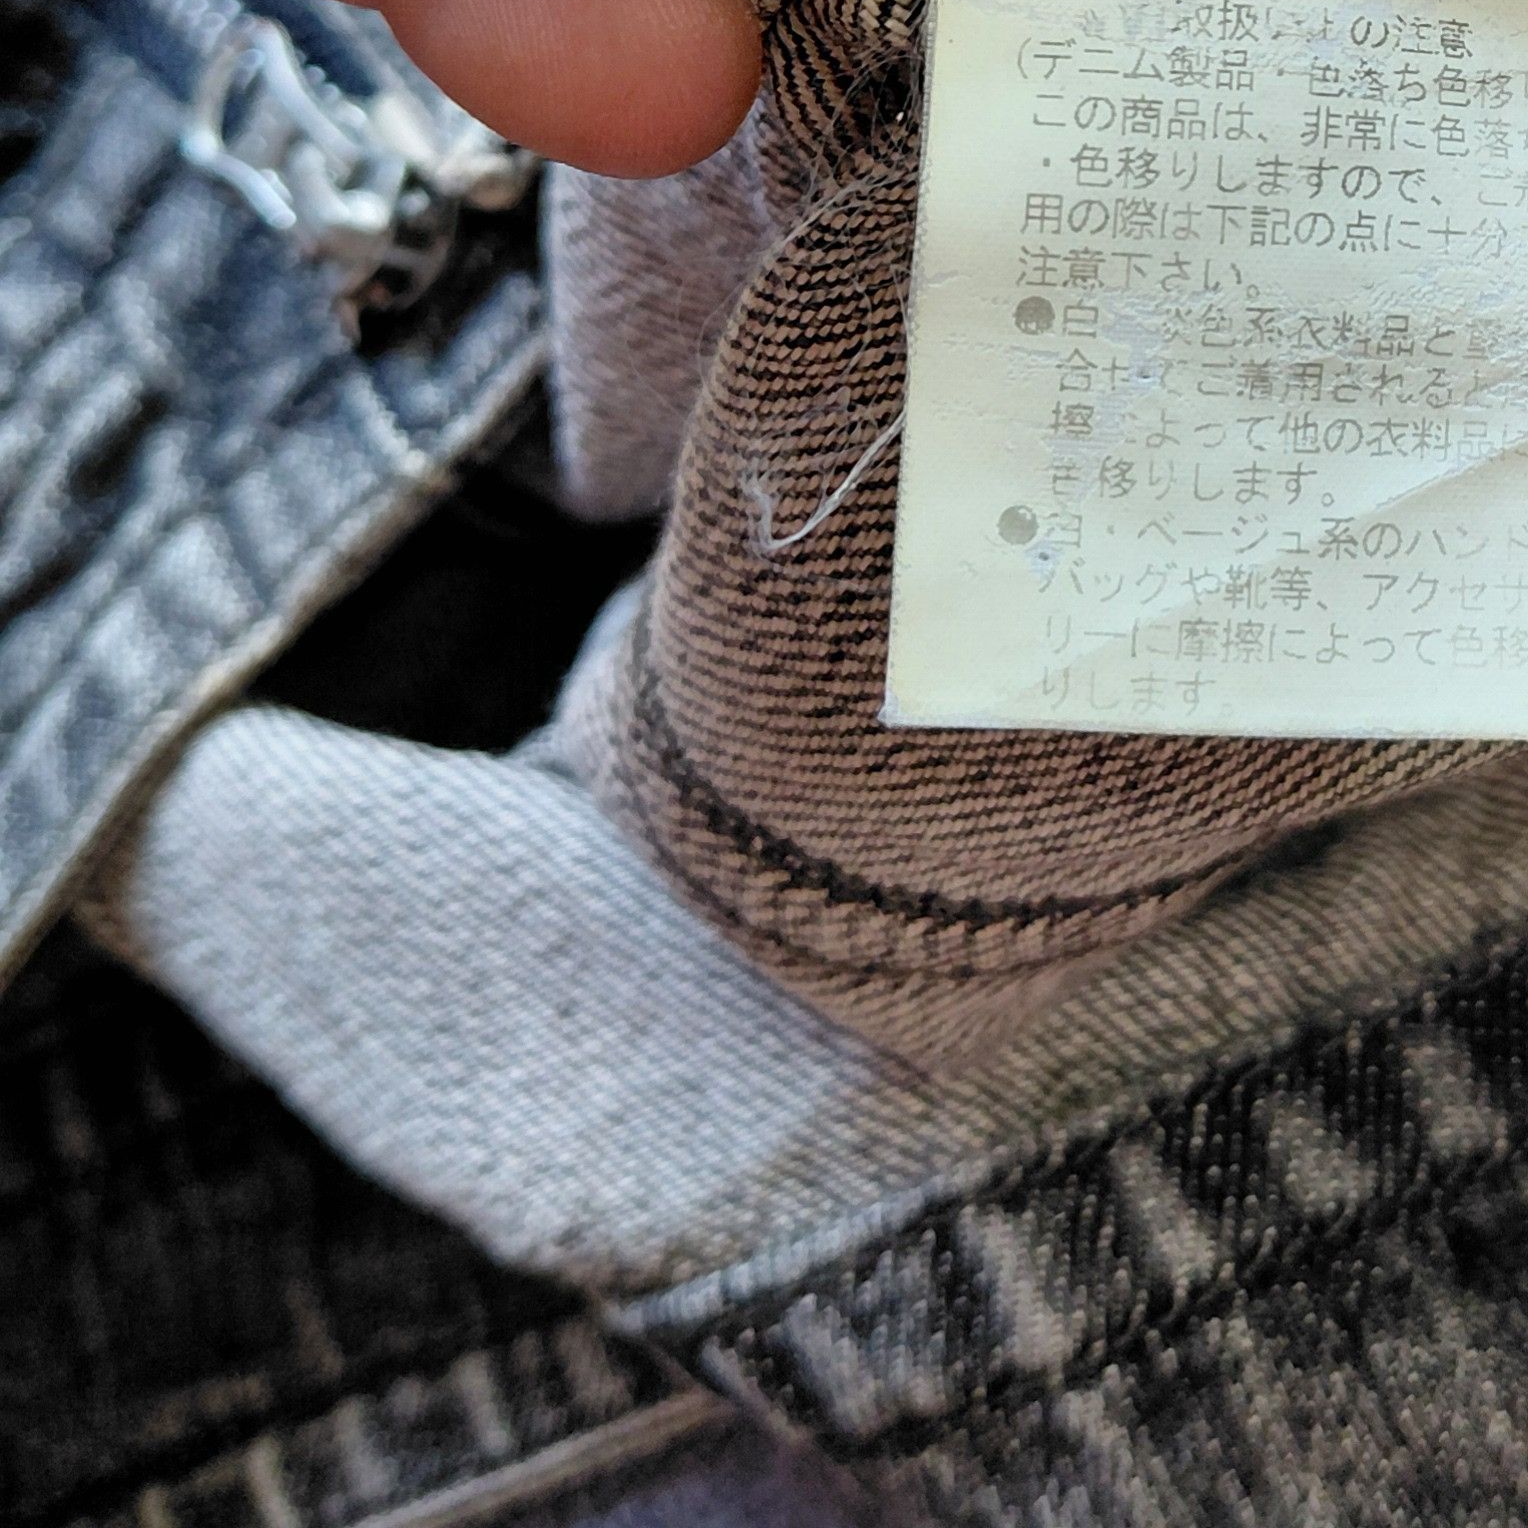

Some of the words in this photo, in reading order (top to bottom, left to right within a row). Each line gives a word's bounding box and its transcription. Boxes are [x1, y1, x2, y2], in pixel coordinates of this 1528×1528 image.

[1016, 244, 1261, 298] 注意下さい。
